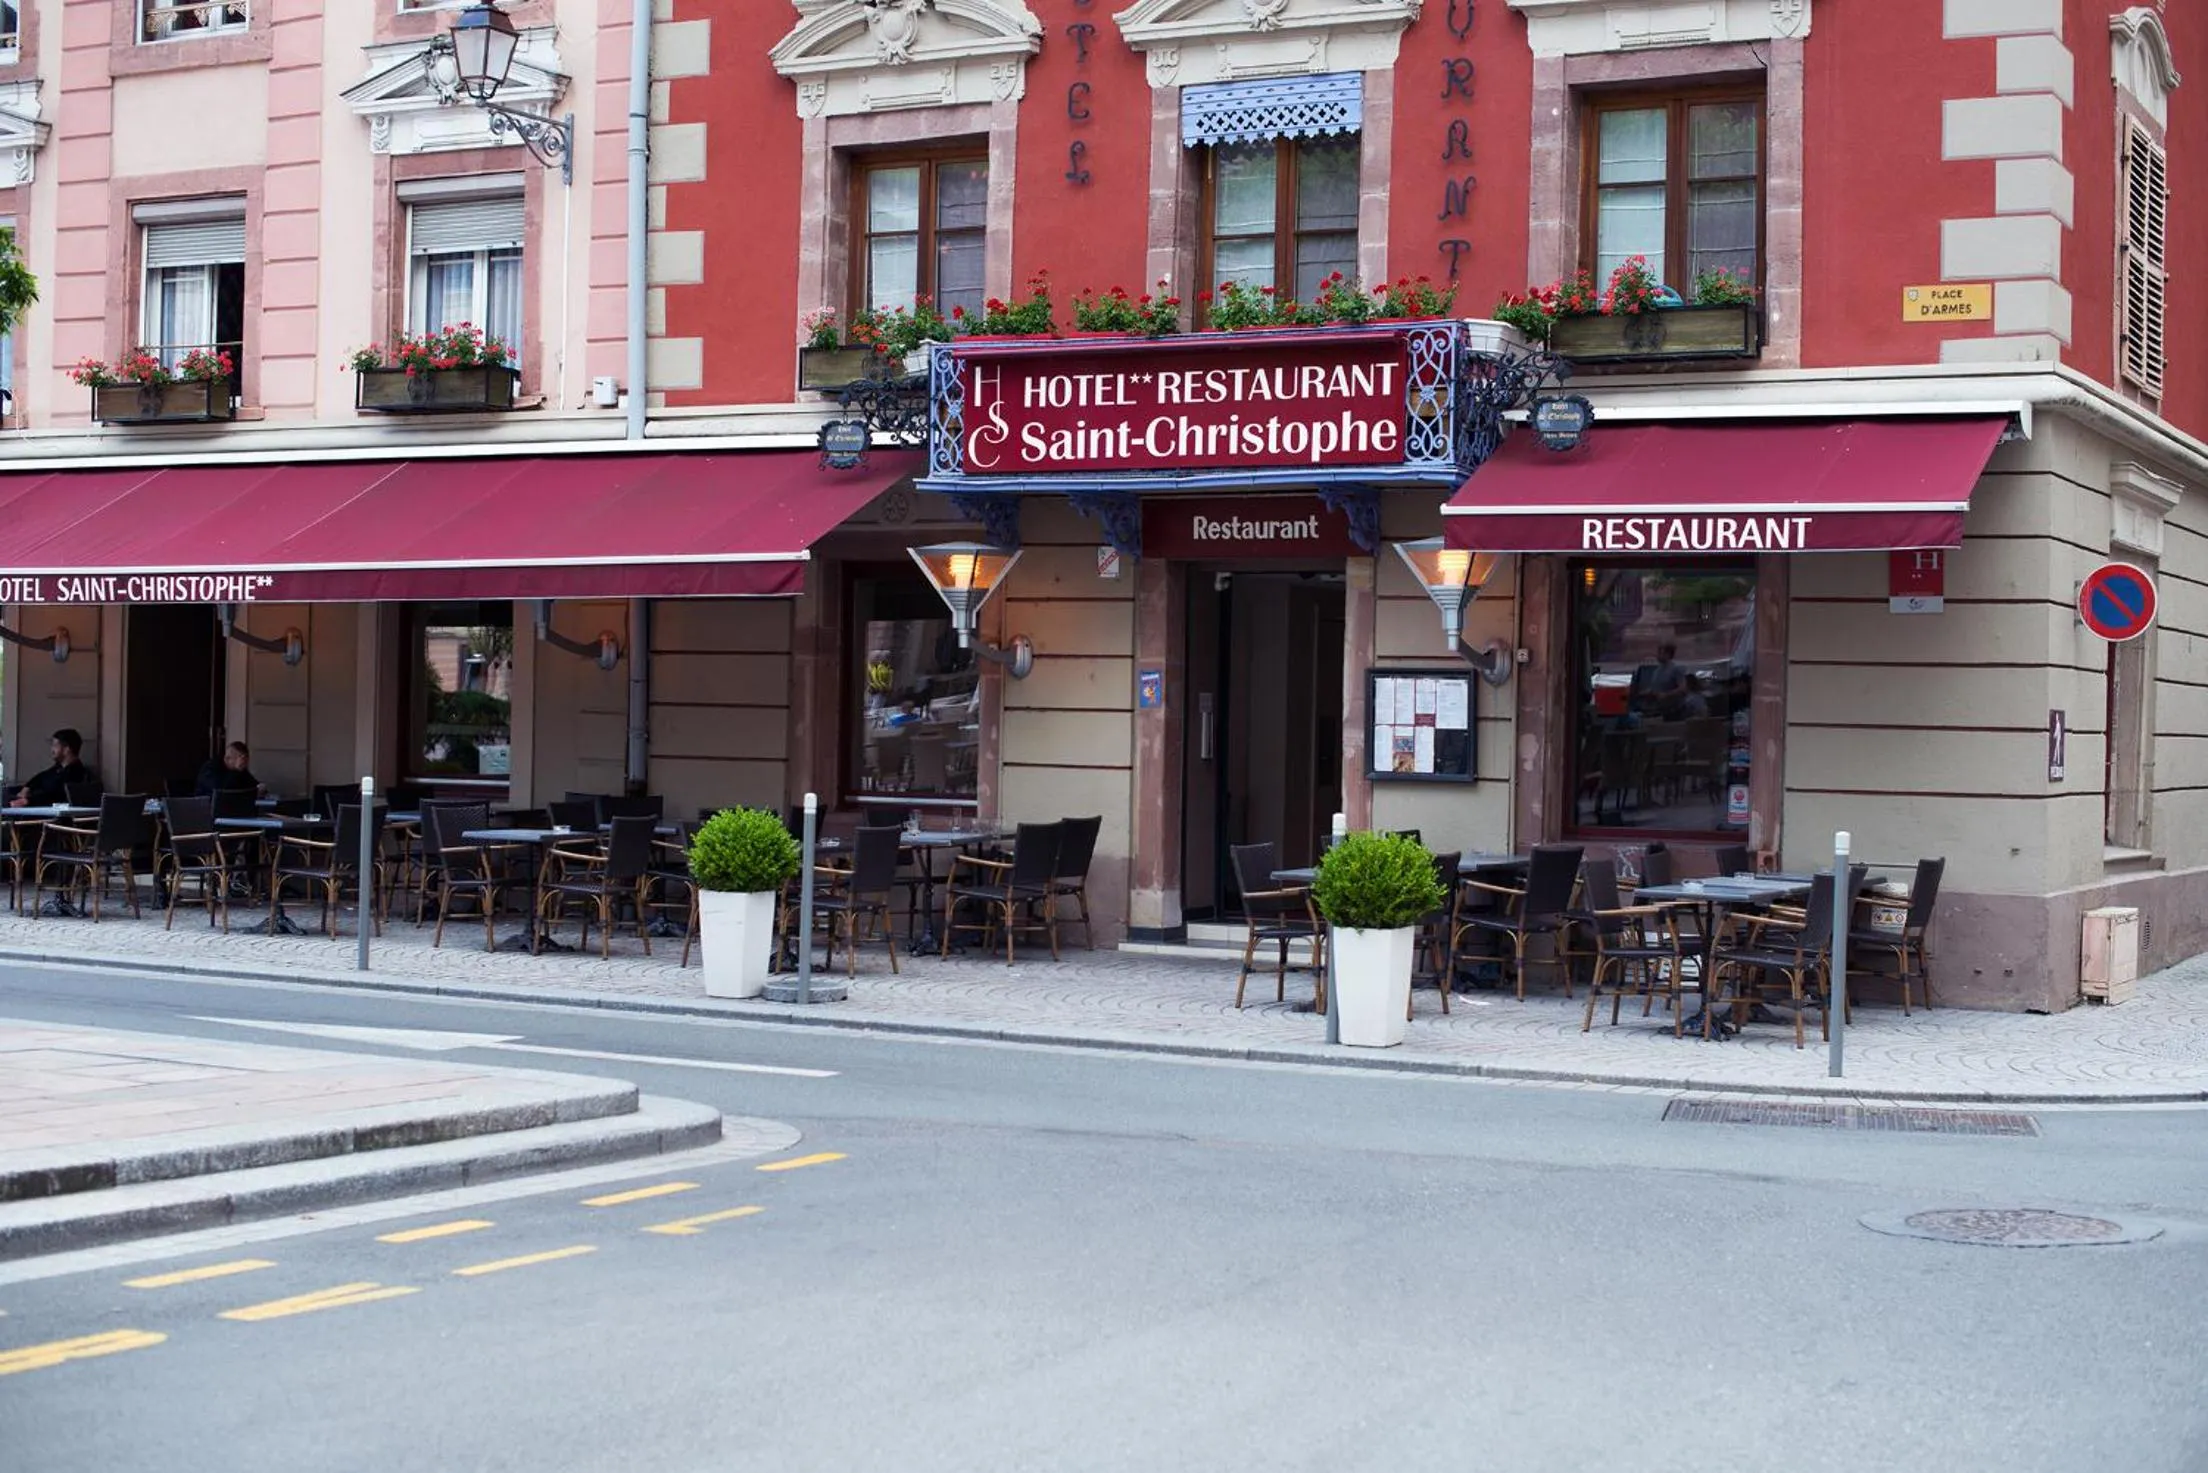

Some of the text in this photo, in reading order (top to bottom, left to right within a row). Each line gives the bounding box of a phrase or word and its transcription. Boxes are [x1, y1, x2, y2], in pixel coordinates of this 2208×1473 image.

[1065, 0, 1096, 185] TEL
[1930, 289, 1964, 300] PLACE
[1920, 303, 1973, 316] D'ARMES
[1157, 362, 1399, 404] RESTAURANT
[1021, 410, 1397, 463] Saint-Christophe
[1192, 514, 1320, 540] Restaurant
[1582, 517, 1813, 550] RESTAURANT
[1914, 551, 1938, 570] H
